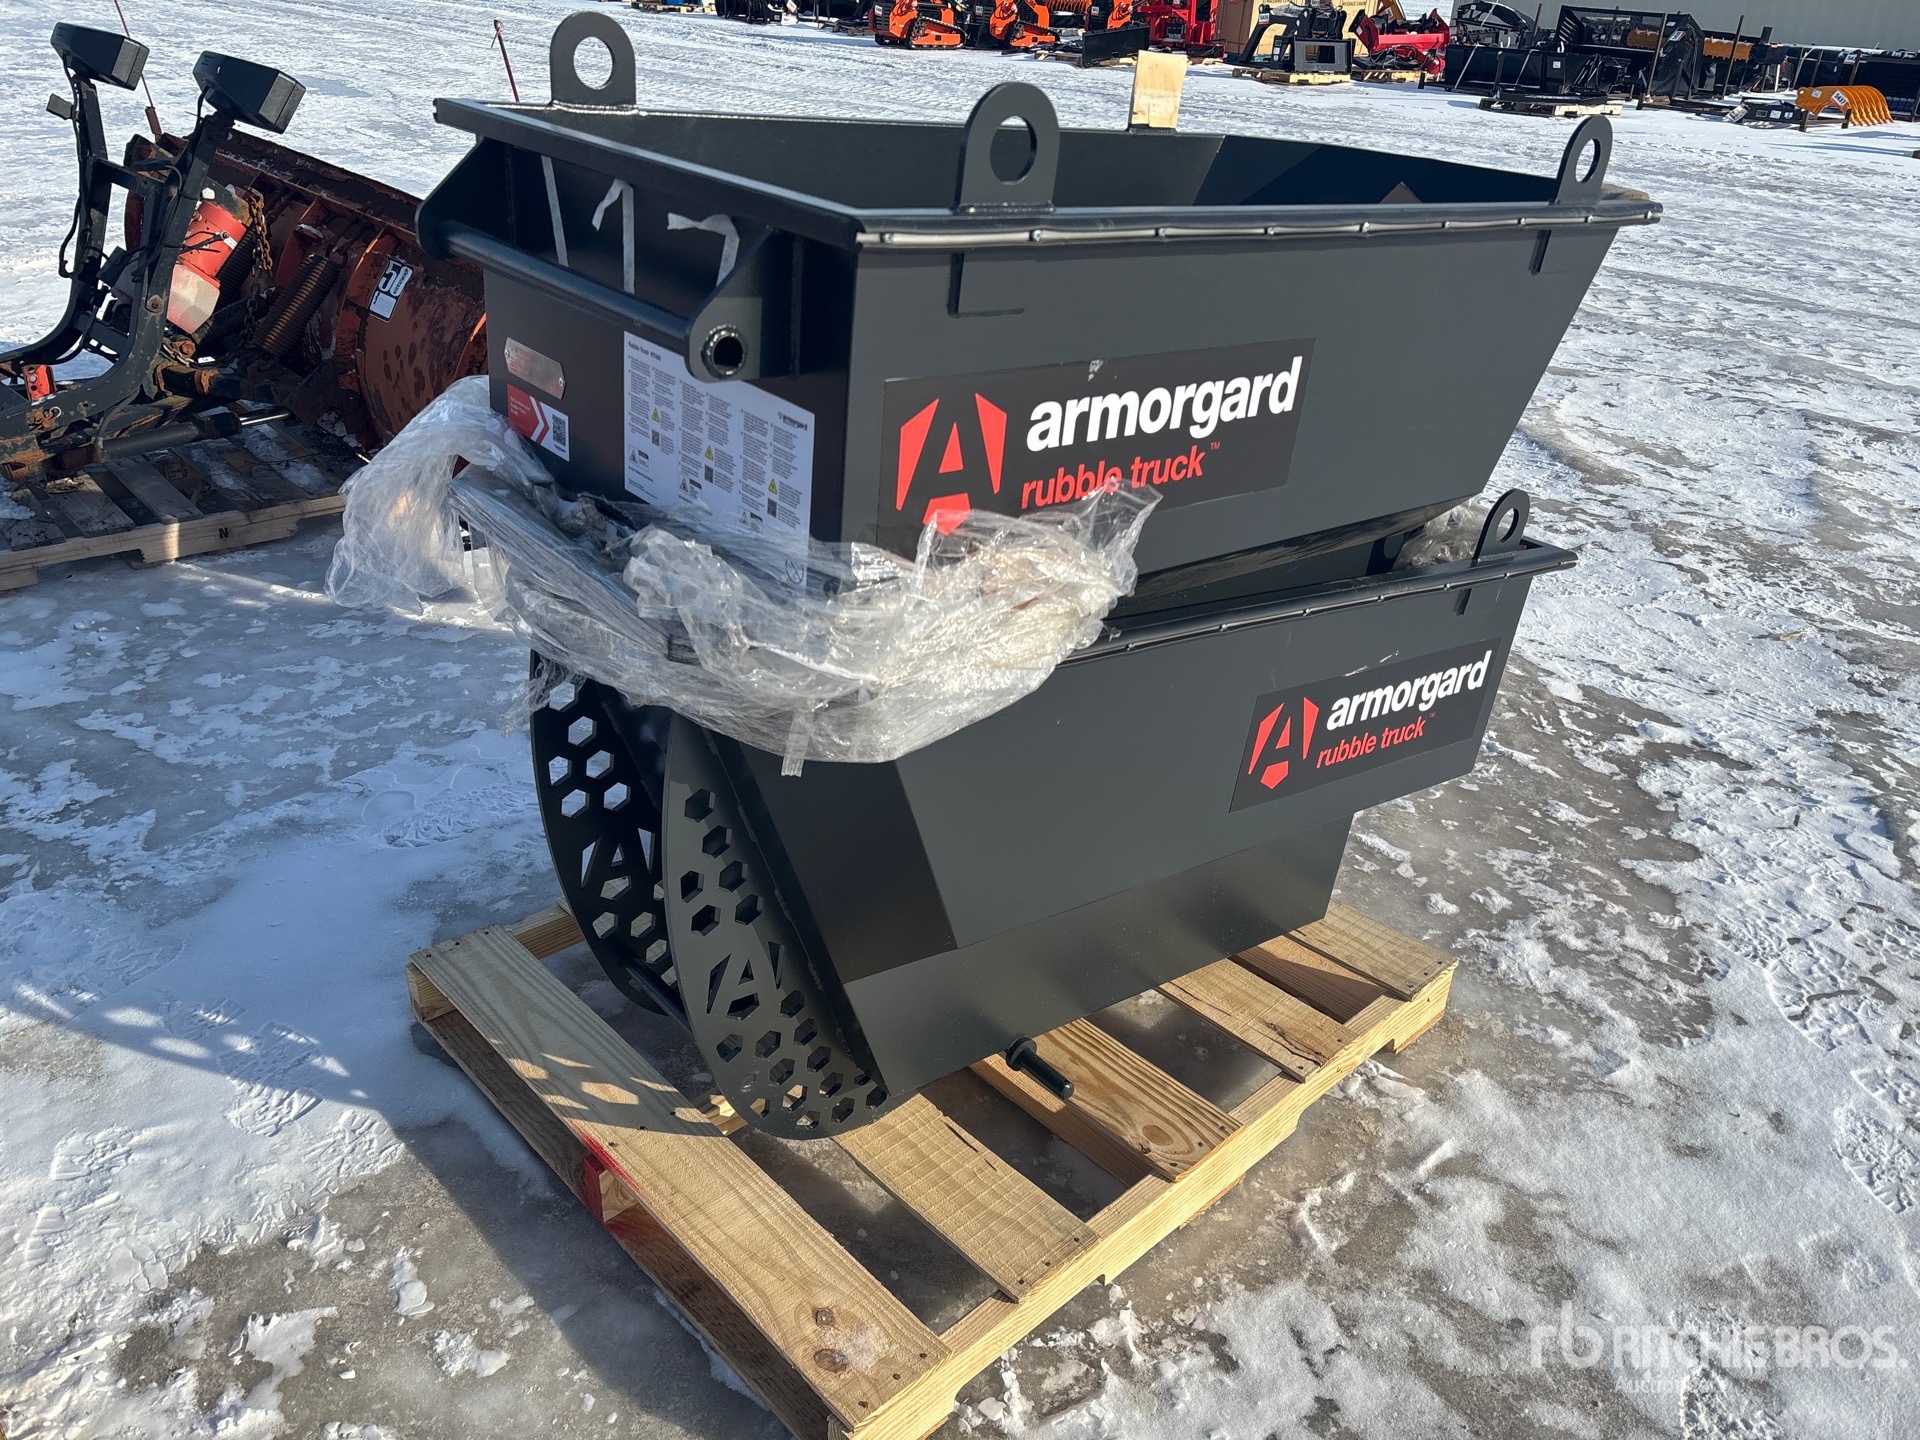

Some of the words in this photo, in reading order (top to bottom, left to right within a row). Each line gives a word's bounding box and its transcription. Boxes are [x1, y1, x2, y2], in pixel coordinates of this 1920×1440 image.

[1026, 355, 1303, 452] armorgard
[1021, 460, 1122, 509] rubble
[1130, 445, 1206, 489] truck
[1326, 650, 1493, 731] armorgard
[1316, 732, 1377, 769] rubble
[1380, 715, 1427, 750] truck
